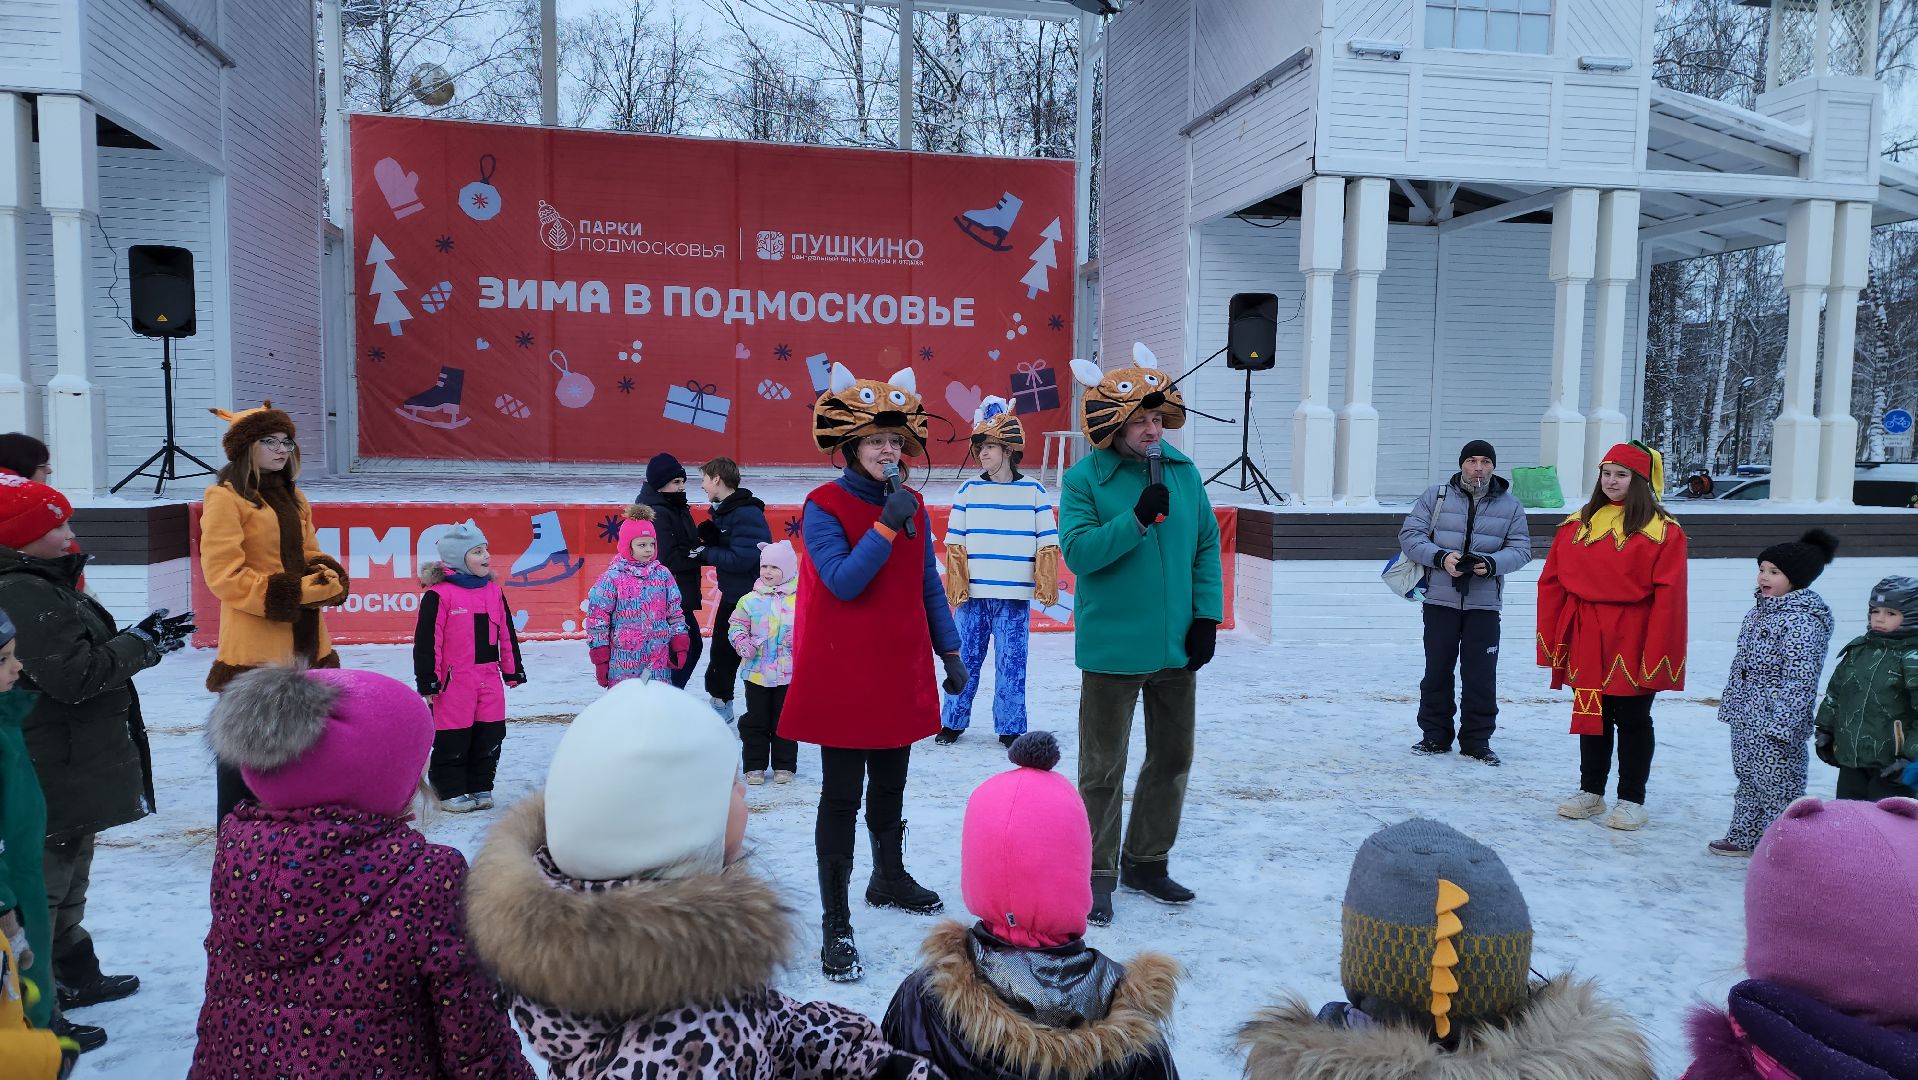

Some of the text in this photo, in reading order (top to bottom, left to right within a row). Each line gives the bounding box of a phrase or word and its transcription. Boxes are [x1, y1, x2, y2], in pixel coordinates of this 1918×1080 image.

[579, 219, 642, 236] ПАРКИ
[580, 237, 725, 258] ПОДМОСКОВЬЯ
[791, 233, 924, 259] ПУШКИНО
[478, 276, 975, 327] ЗИМА В ПОДМОСКОВЬЕ
